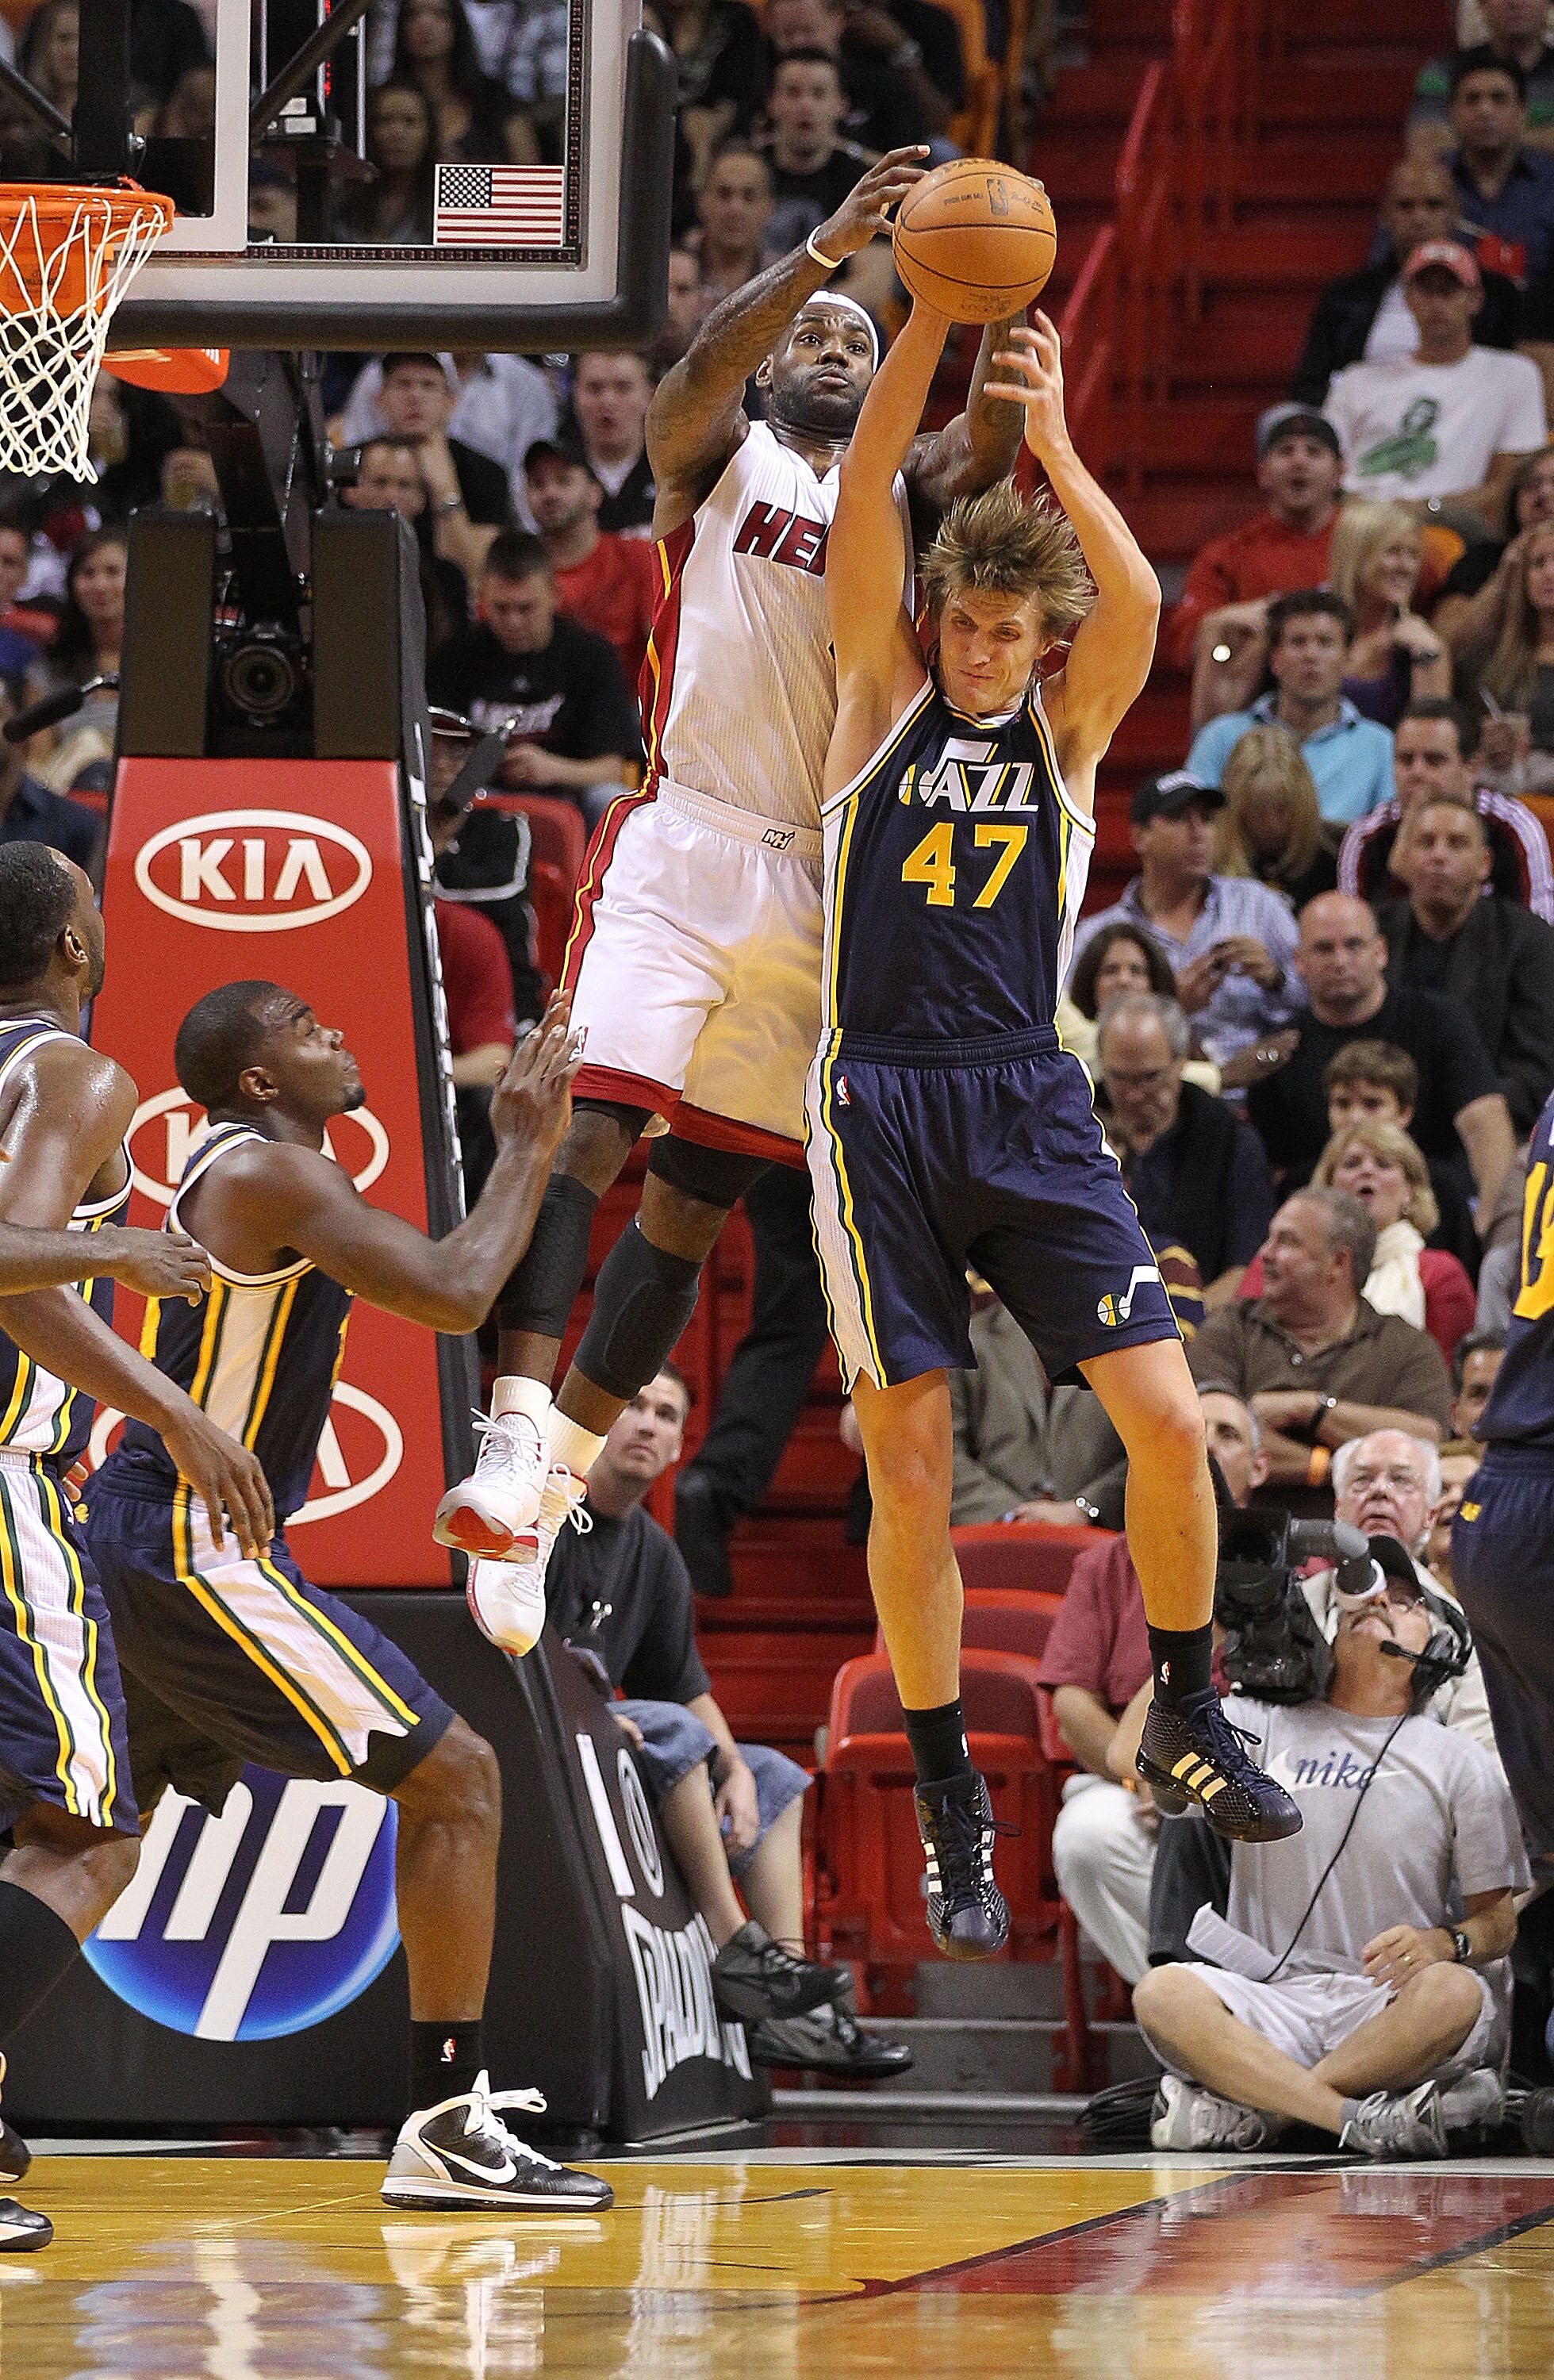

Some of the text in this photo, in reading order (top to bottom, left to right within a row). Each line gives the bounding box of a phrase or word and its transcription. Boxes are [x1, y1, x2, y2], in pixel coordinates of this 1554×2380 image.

[732, 500, 827, 577] HE
[899, 737, 1038, 812] JAZZ
[178, 838, 334, 900] KIA
[902, 822, 1028, 908] 47
